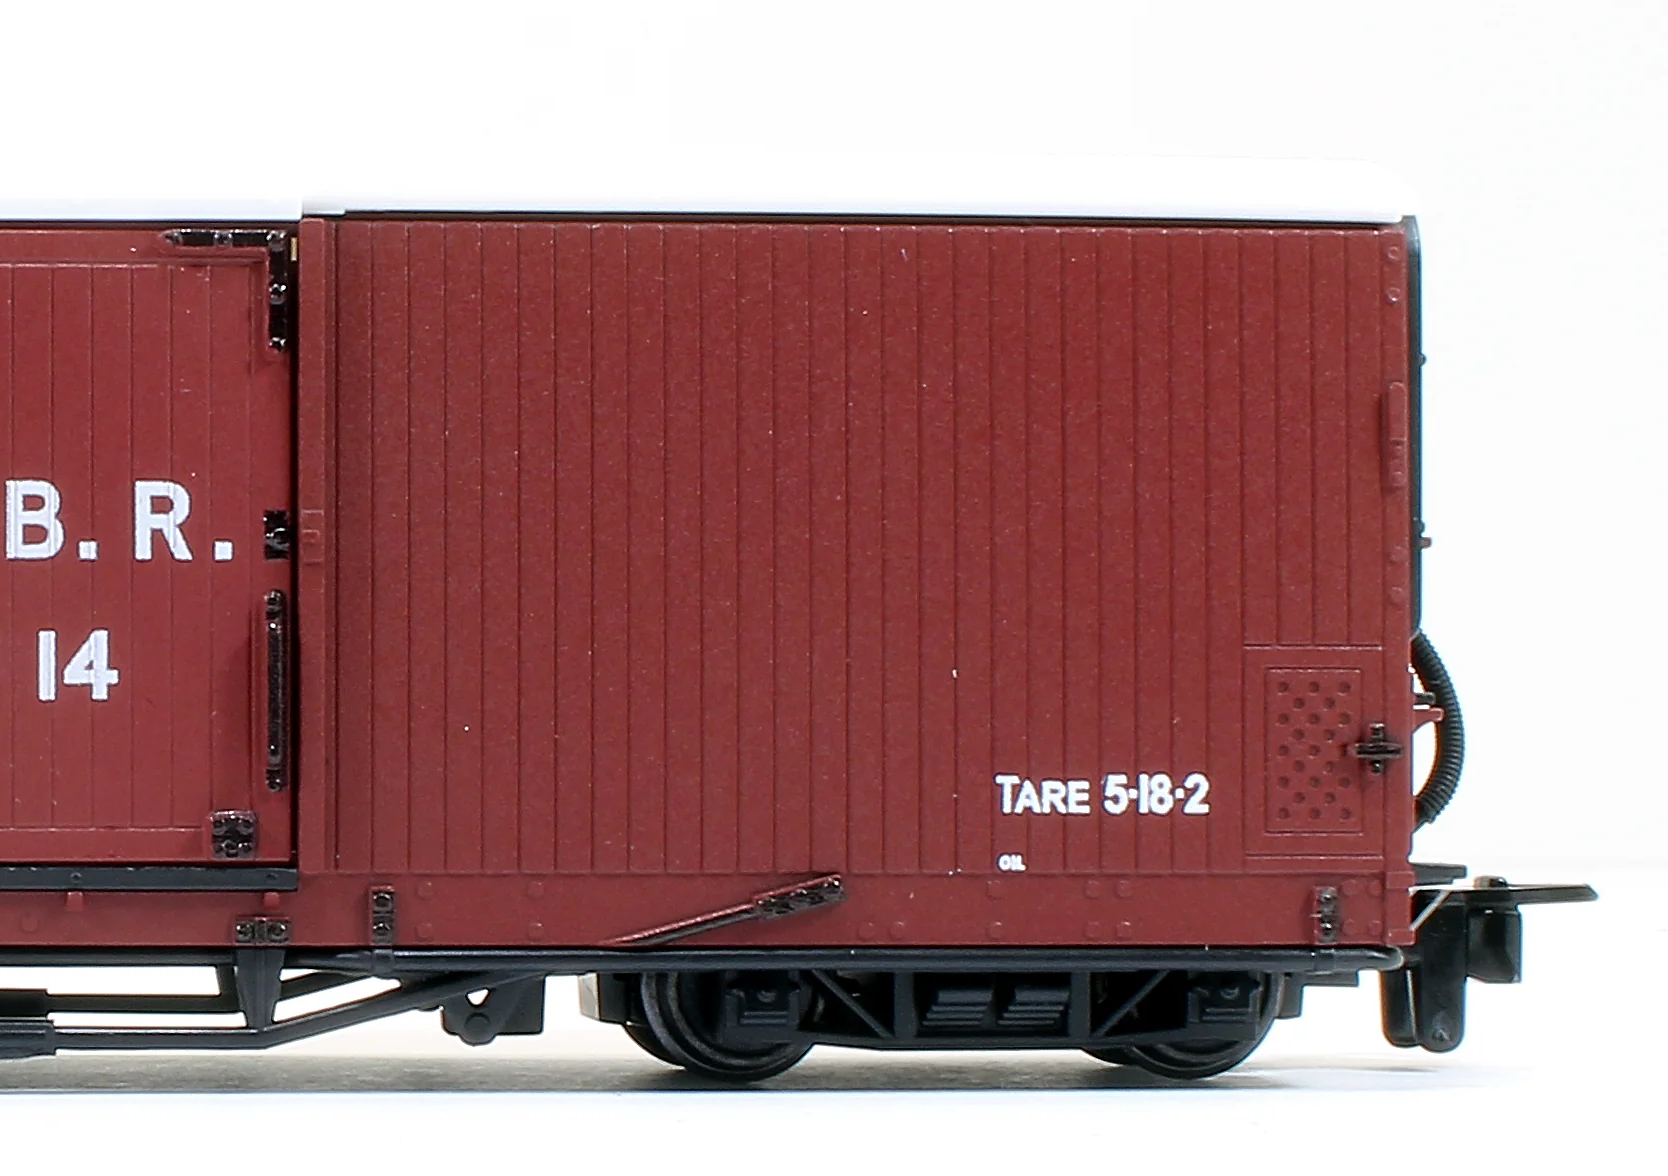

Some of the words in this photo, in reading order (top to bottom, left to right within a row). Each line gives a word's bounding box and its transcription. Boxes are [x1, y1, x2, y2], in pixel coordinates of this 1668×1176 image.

[38, 629, 119, 701] 14
[995, 774, 1091, 814] TARE
[998, 854, 1027, 872] OIL
